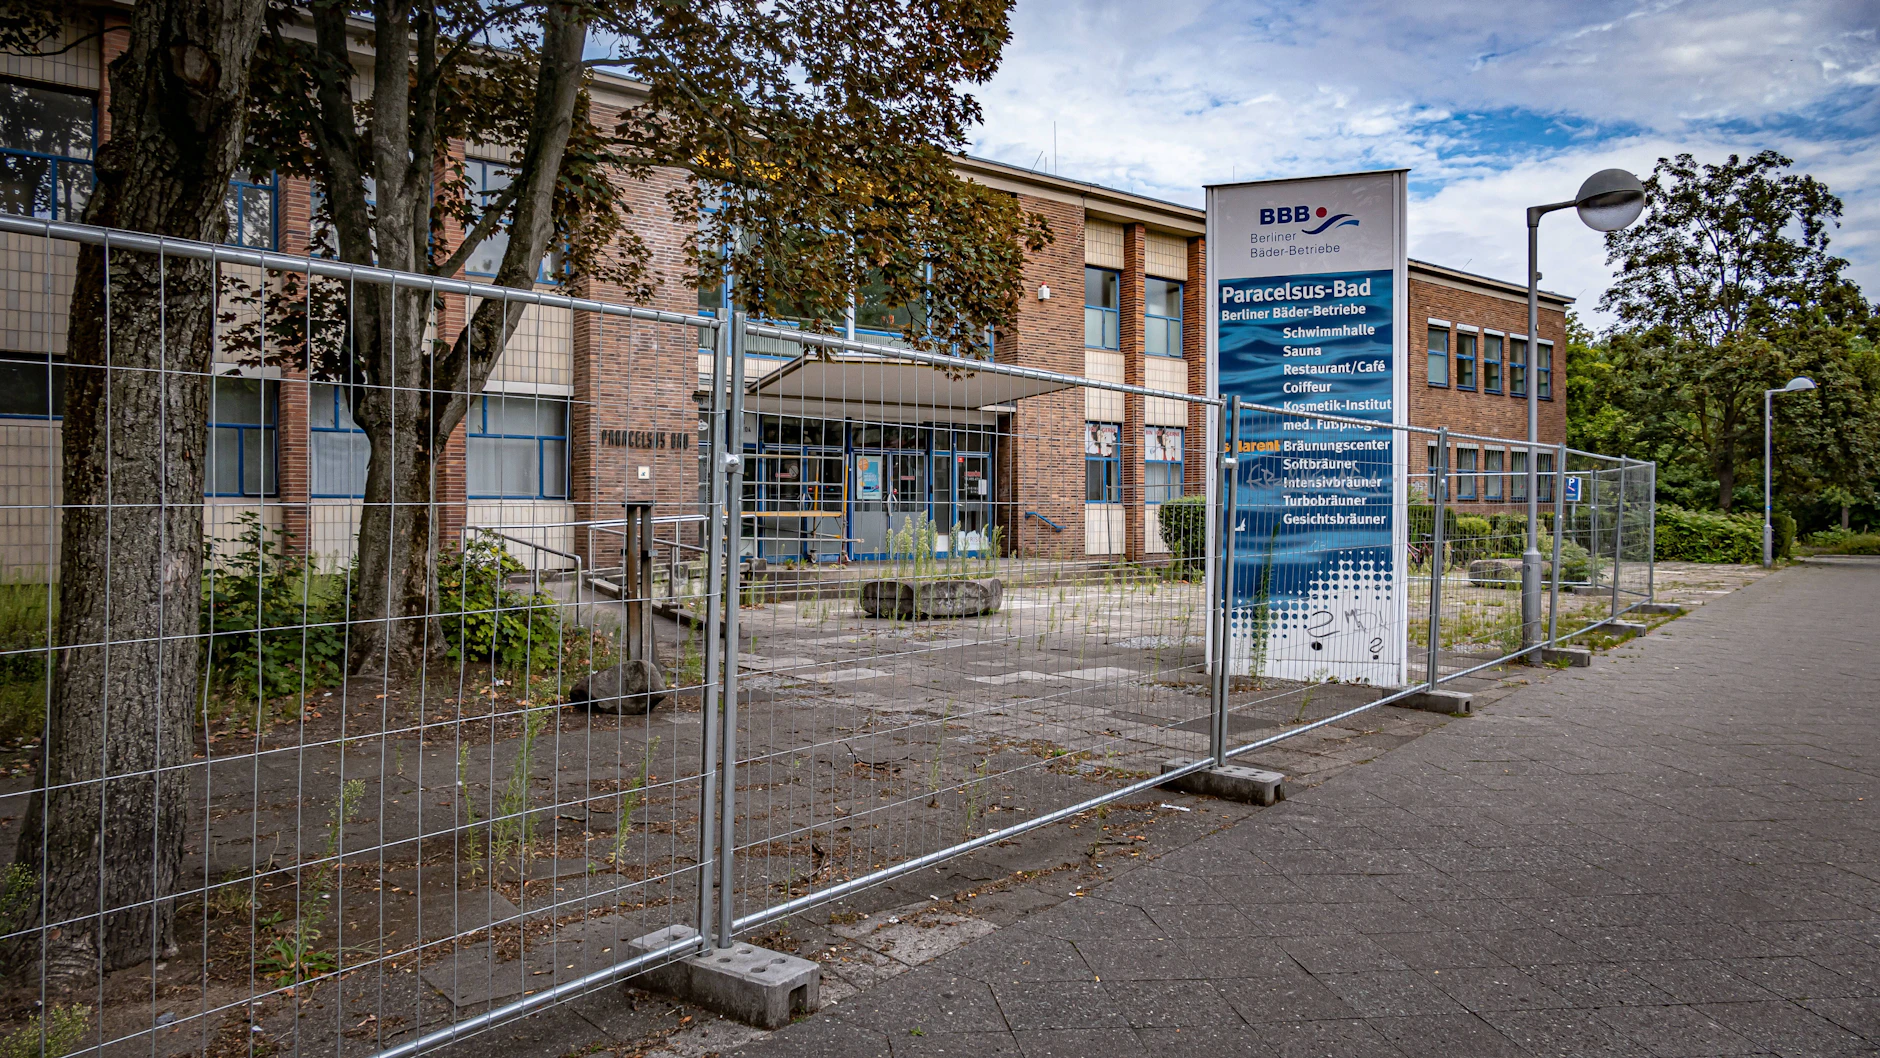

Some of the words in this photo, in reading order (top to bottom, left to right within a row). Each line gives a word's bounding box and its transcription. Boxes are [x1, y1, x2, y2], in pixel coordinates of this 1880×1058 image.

[1259, 205, 1310, 226] BBB
[1250, 232, 1297, 244] Berliner
[1250, 243, 1341, 259] Bäder-Betriebe
[1221, 278, 1371, 304] Paracelsus-Bad
[1221, 308, 1270, 322] Berliner
[1272, 303, 1367, 319] Bäder-Betriebe
[1282, 323, 1376, 340] Schwimmhalle
[1282, 345, 1322, 358] Sauna
[1283, 359, 1386, 376] Restaurant/Café
[1282, 381, 1332, 395] Coiffeur
[1283, 397, 1392, 412] Kosmetik-Institut
[1283, 418, 1314, 432] med.
[1316, 417, 1379, 433] Fußpg
[601, 429, 666, 449] PARACELSUS
[670, 432, 689, 449] BAD
[1223, 439, 1281, 453] slarent
[1283, 438, 1391, 454] Bräunungscenter
[1283, 458, 1358, 471] Softbräuner
[1283, 475, 1383, 490] Intensivbräuner
[1569, 478, 1575, 486] P
[1283, 494, 1368, 507] Turbobräuner
[1283, 512, 1387, 526] Gesichtsbräuner
